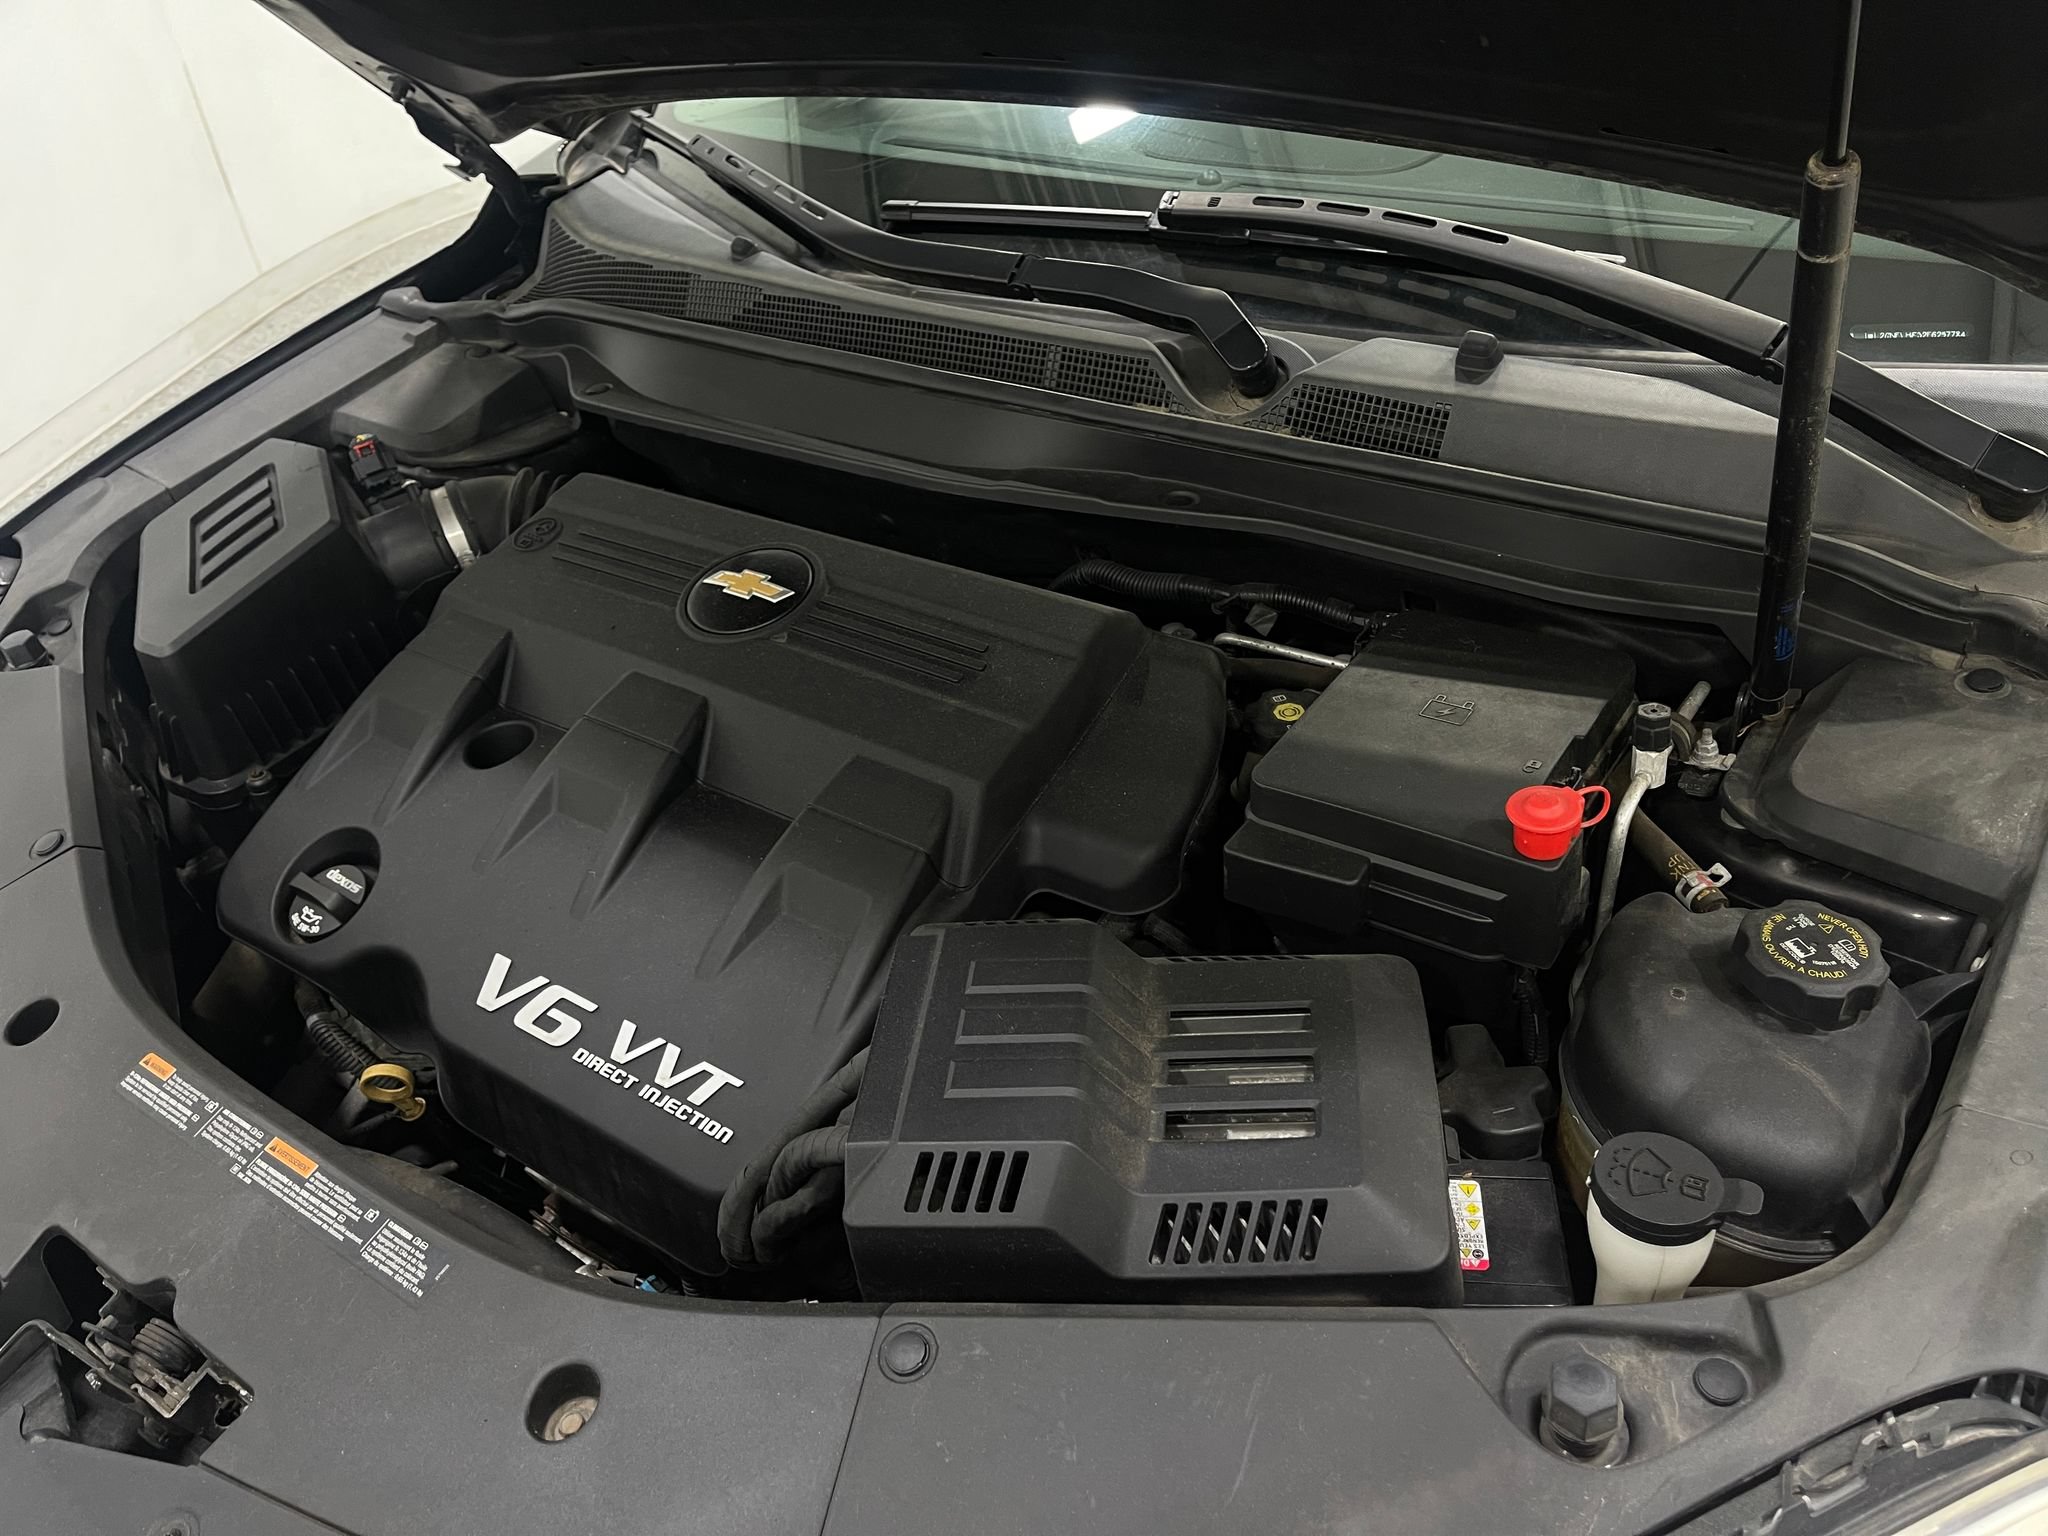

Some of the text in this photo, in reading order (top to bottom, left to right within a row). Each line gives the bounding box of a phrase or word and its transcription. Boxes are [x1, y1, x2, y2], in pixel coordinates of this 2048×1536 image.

[326, 869, 363, 893] dexos
[1817, 912, 1848, 930] NEVER
[1845, 927, 1865, 946] OPEN
[1765, 943, 1796, 970] OUVRIR
[1807, 969, 1848, 979] CHAUD!
[476, 952, 745, 1106] V6 VVT
[572, 1047, 735, 1145] DIRECT INJECTION
